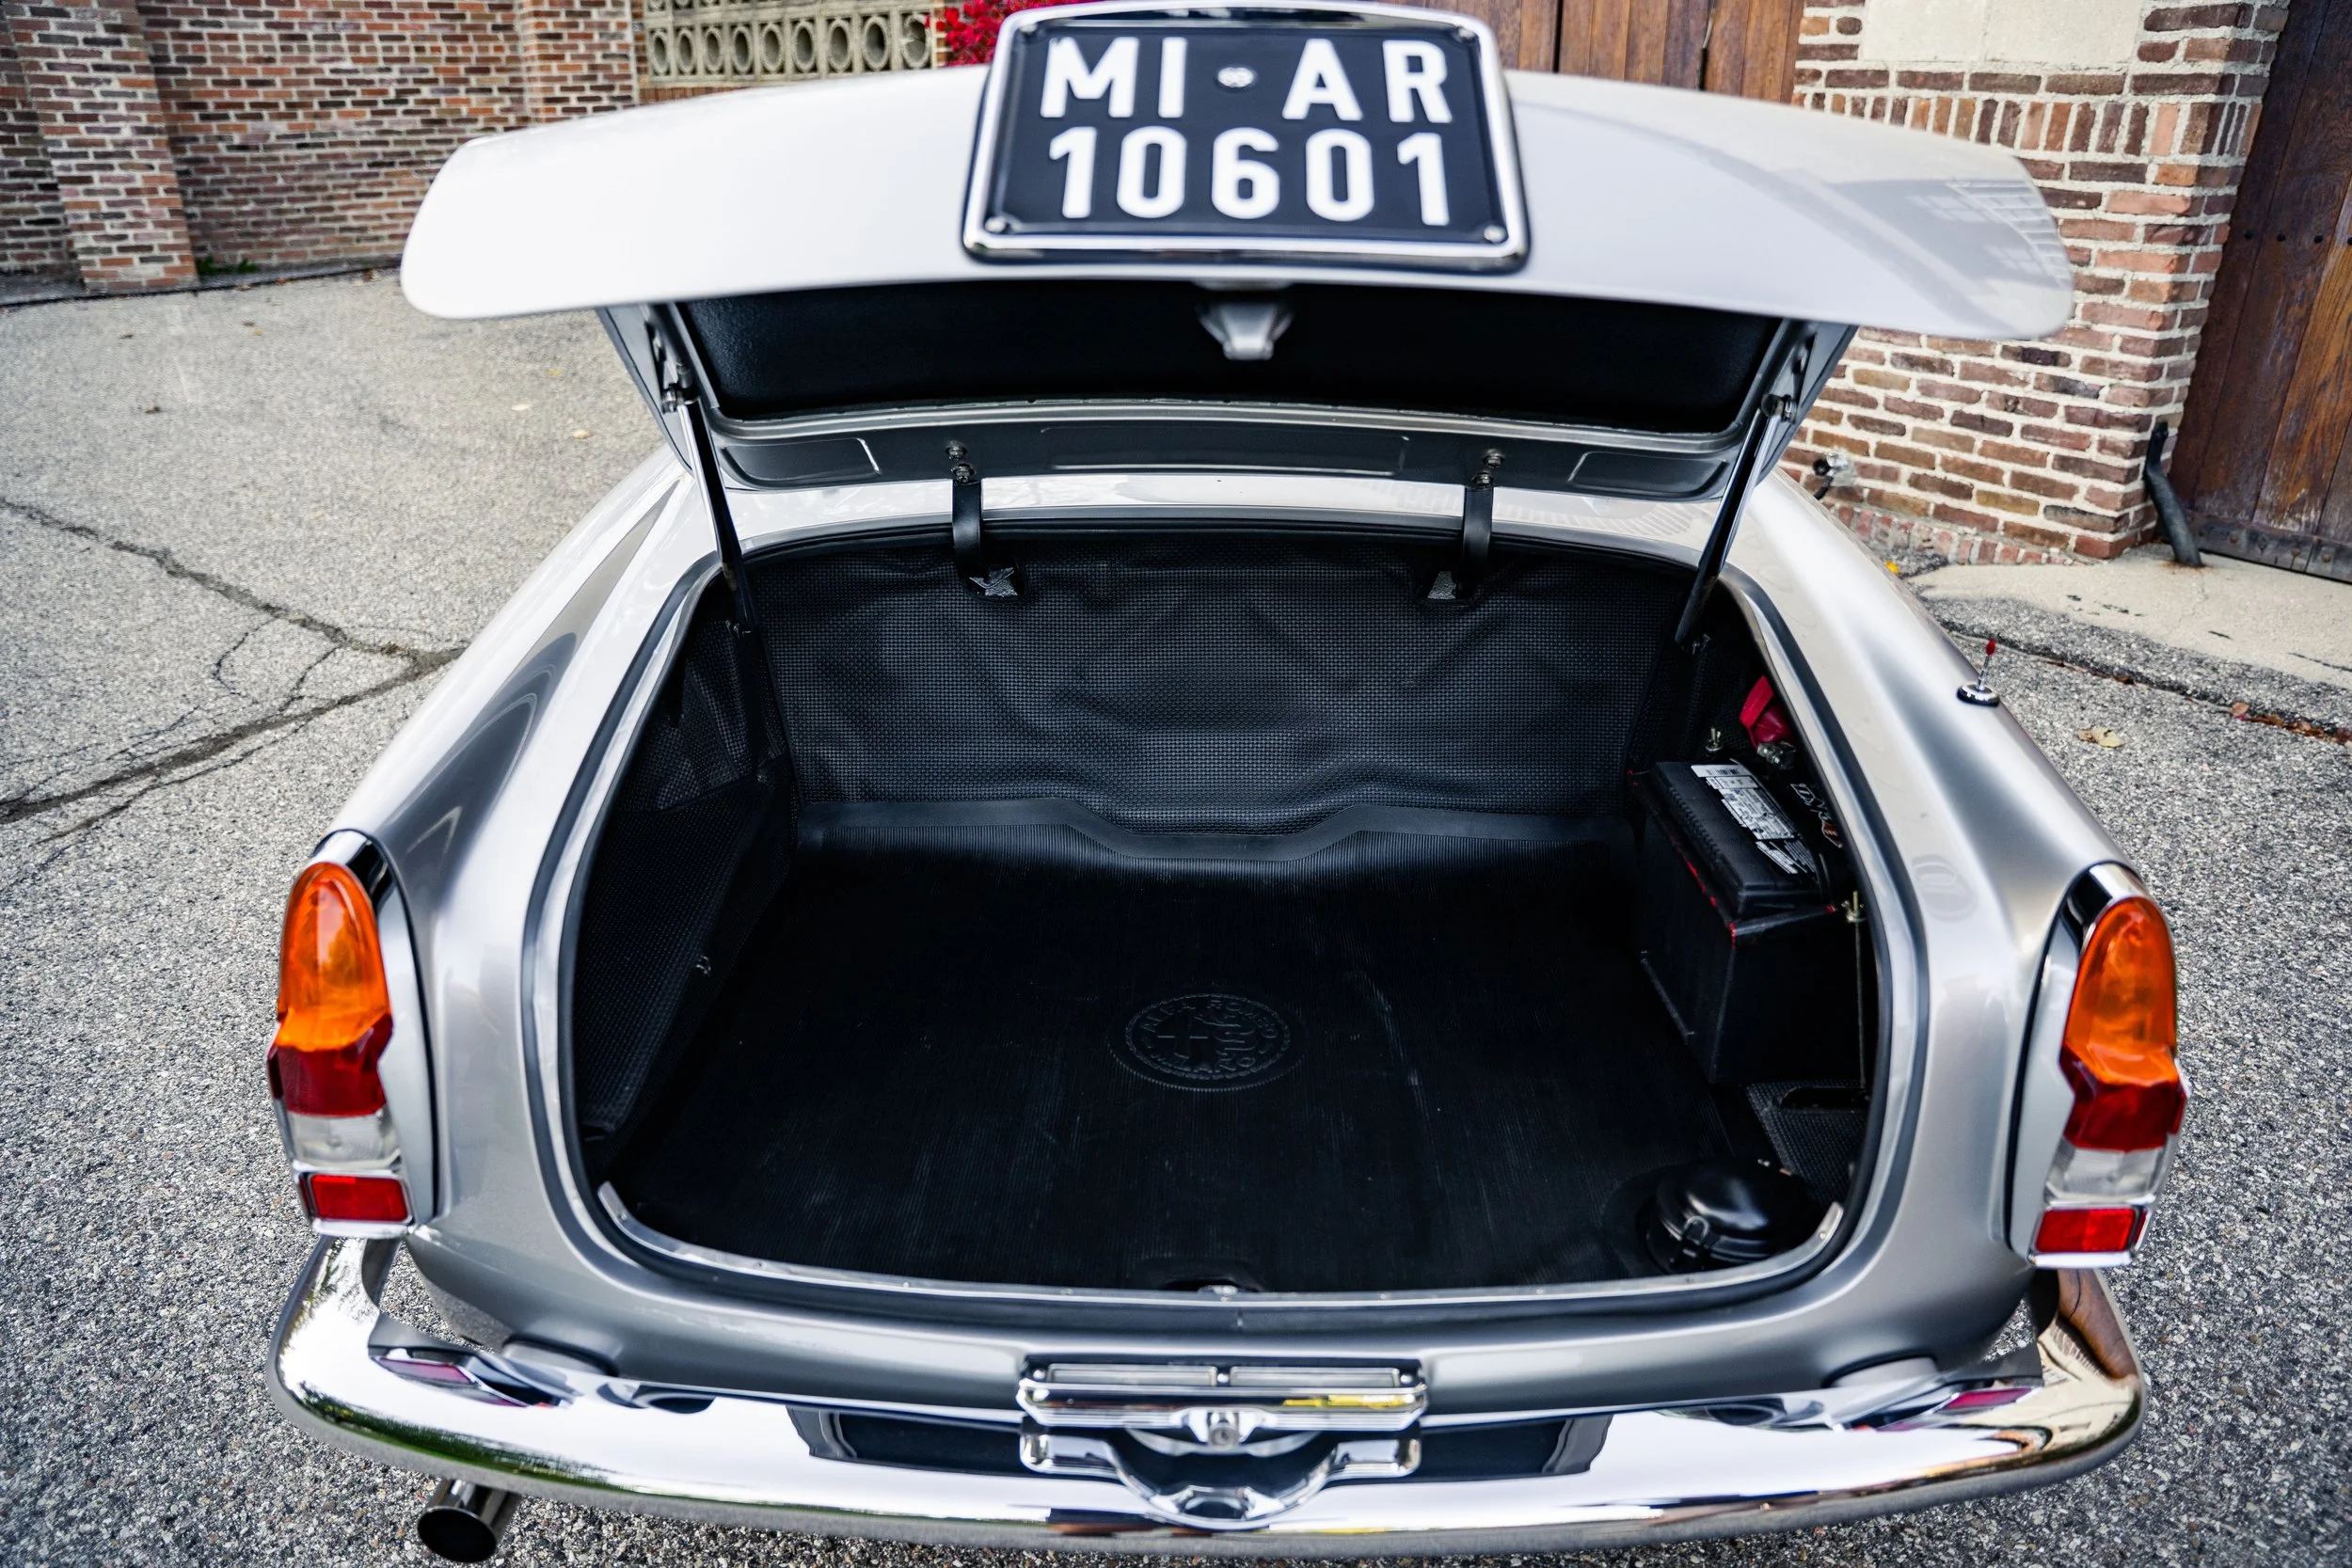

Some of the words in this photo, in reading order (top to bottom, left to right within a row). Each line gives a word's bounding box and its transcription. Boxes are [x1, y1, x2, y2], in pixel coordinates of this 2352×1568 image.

[1041, 37, 1187, 118] MI
[1282, 39, 1452, 122] AR
[1050, 126, 1449, 226] 10601
